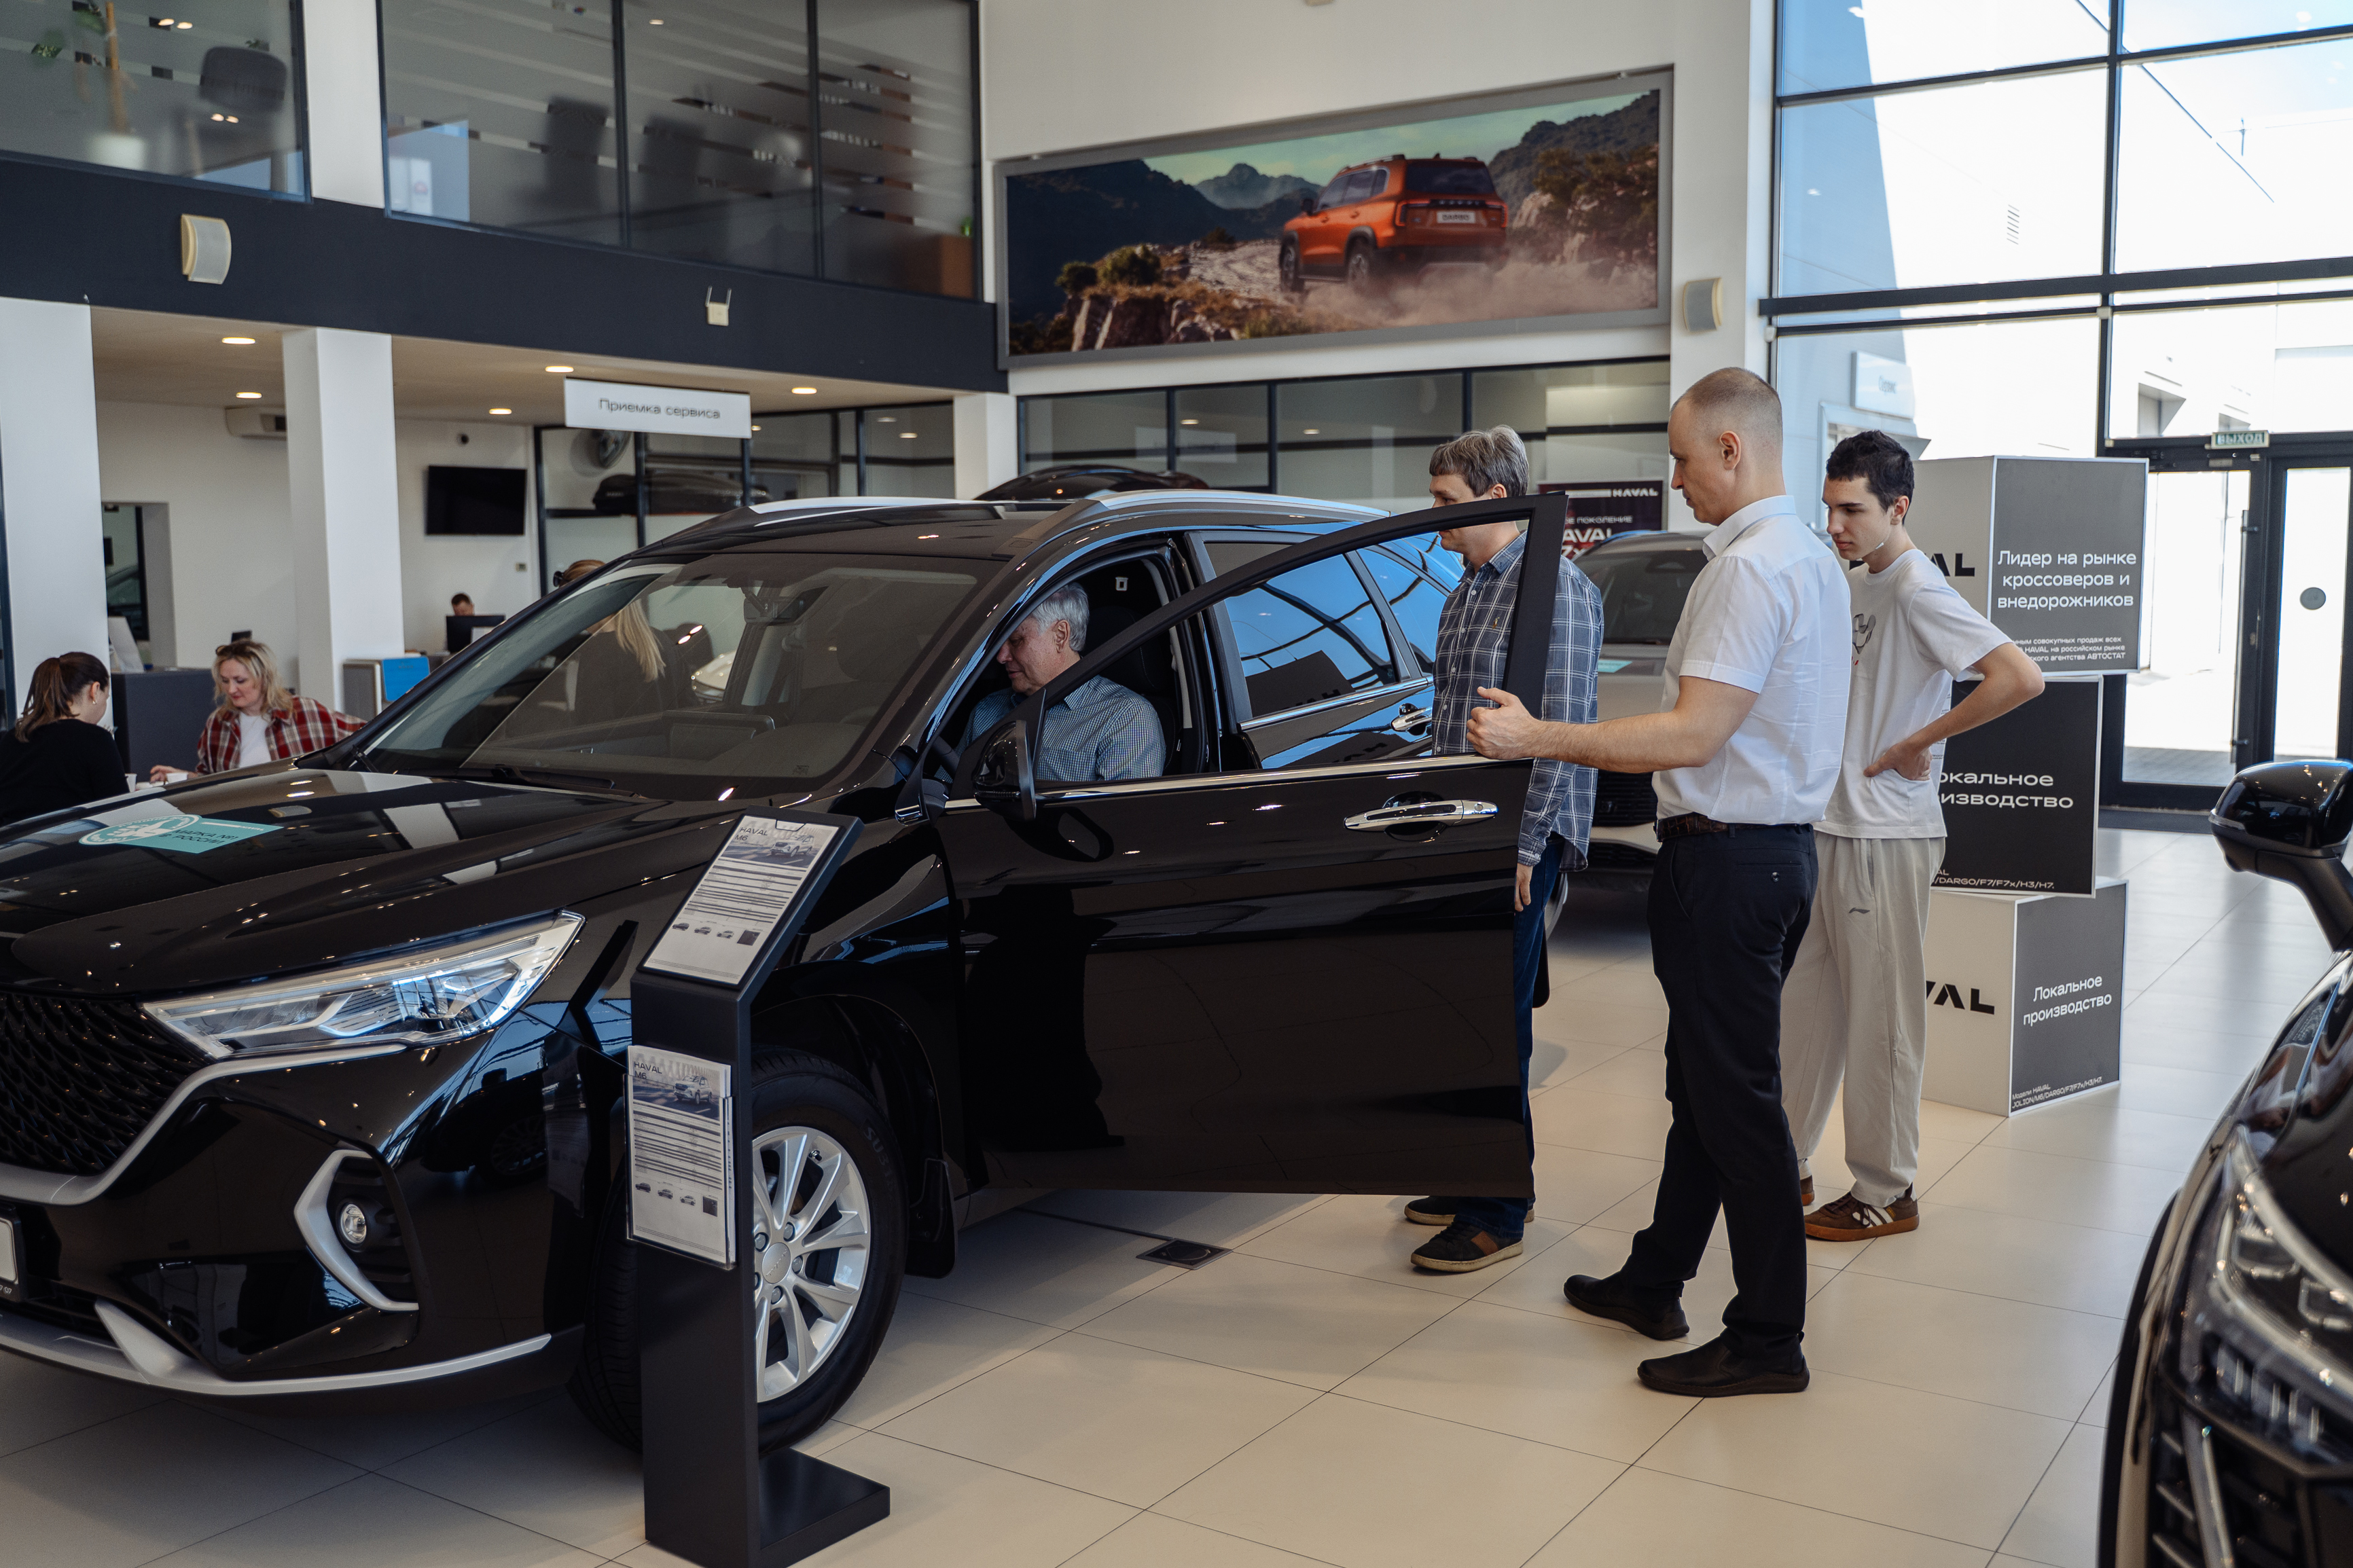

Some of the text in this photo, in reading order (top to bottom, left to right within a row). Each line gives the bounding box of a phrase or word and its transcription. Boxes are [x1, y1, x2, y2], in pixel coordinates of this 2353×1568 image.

[599, 398, 721, 420] Приемка сервиса
[2217, 433, 2263, 445] ВЫХОД
[1612, 488, 1659, 497] HAVAL
[1577, 515, 1633, 524] ПОКОЛЕНИЕ
[1998, 551, 2136, 568] Лидер на рынке
[2002, 574, 2130, 589] кроссоверов и
[1998, 595, 2134, 610] внедорожников
[2061, 645, 2102, 653] российском
[2050, 653, 2086, 661] агентства
[2087, 652, 2126, 660] АВТОСТАТ
[1940, 771, 2053, 786] окальное
[1939, 792, 2074, 808] изводство
[172, 829, 216, 838] МАРКА
[739, 827, 768, 836] HAVAL
[2033, 976, 2102, 1002] Локальное
[2023, 993, 2112, 1027] производство
[634, 1061, 662, 1074] HAVAL
[634, 1070, 647, 1080] M6
[2012, 1083, 2051, 1100] Модели HAVAL
